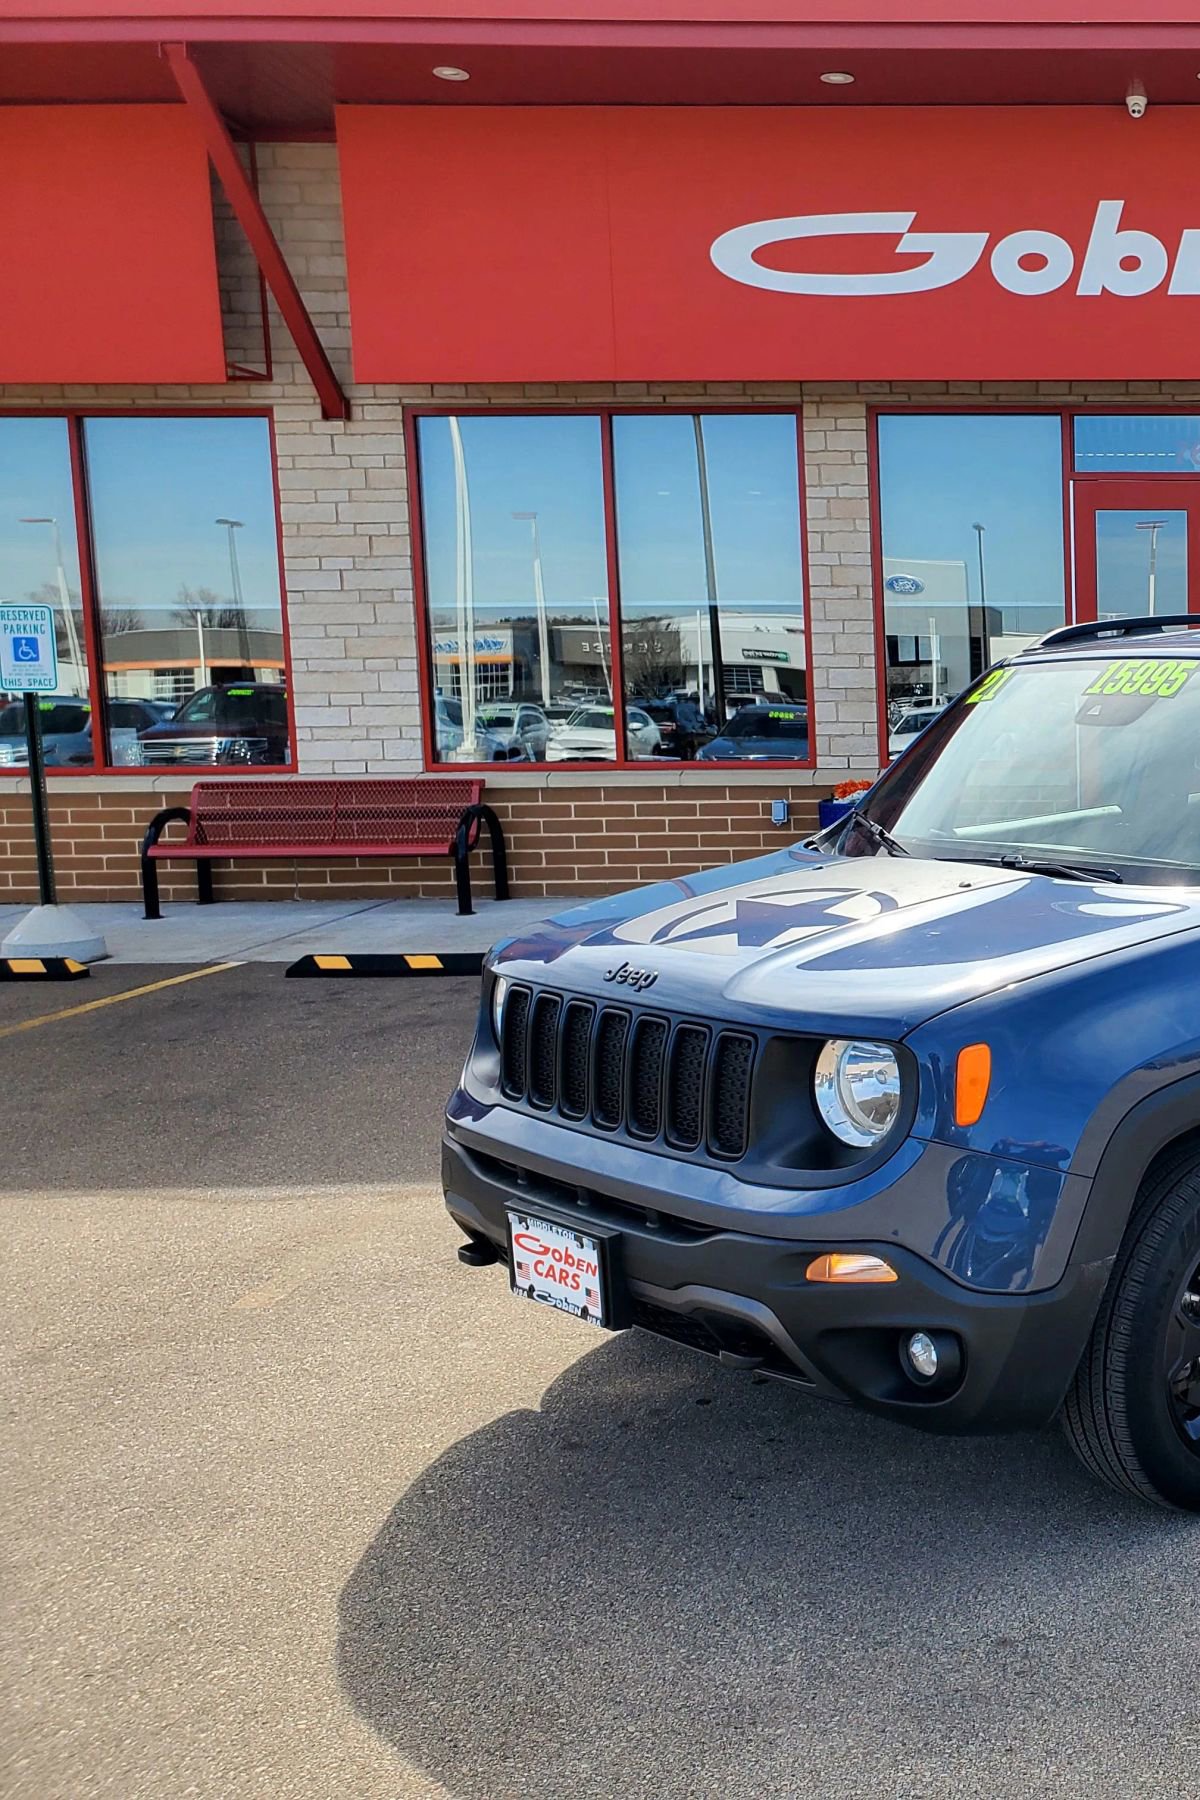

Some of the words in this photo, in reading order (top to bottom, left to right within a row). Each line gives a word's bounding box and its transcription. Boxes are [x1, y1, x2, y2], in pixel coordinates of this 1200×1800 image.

[0, 610, 46, 621] RESERVED
[4, 624, 46, 635] PARKING
[4, 678, 23, 687] THIS
[28, 678, 53, 687] SPACE
[966, 668, 1016, 704] 21
[1085, 661, 1198, 696] 15995
[603, 961, 659, 993] Jeep
[527, 1218, 576, 1240] MIDDLETON
[533, 1259, 581, 1291] CARS
